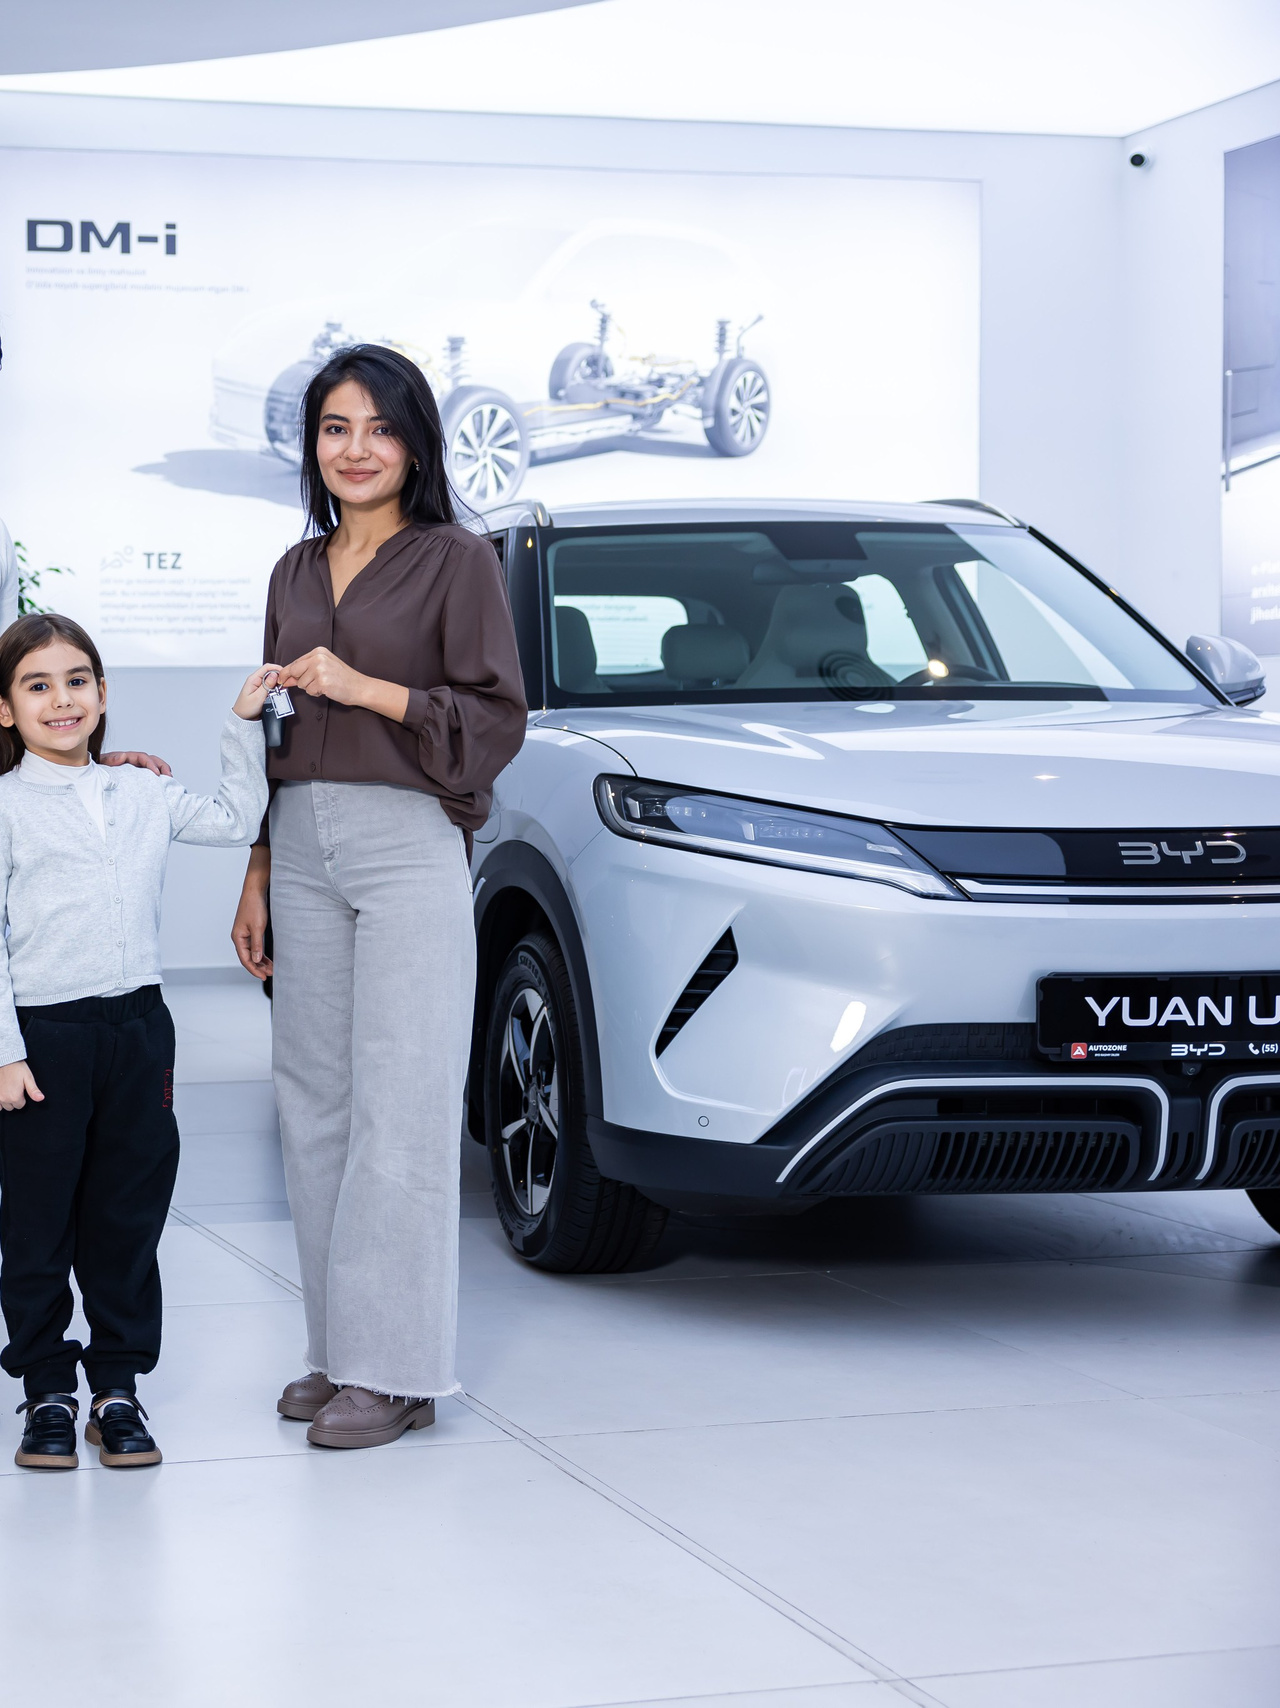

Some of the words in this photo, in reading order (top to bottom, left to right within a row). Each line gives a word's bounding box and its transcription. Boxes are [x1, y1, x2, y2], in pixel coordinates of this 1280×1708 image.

[27, 219, 177, 256] DM-i
[143, 552, 183, 570] TEZ
[1118, 840, 1247, 865] BYD
[1084, 995, 1233, 1027] YUAN
[1088, 1044, 1128, 1052] AUTOZONE
[1170, 1043, 1226, 1057] BYD
[1261, 1042, 1279, 1054] (55)
